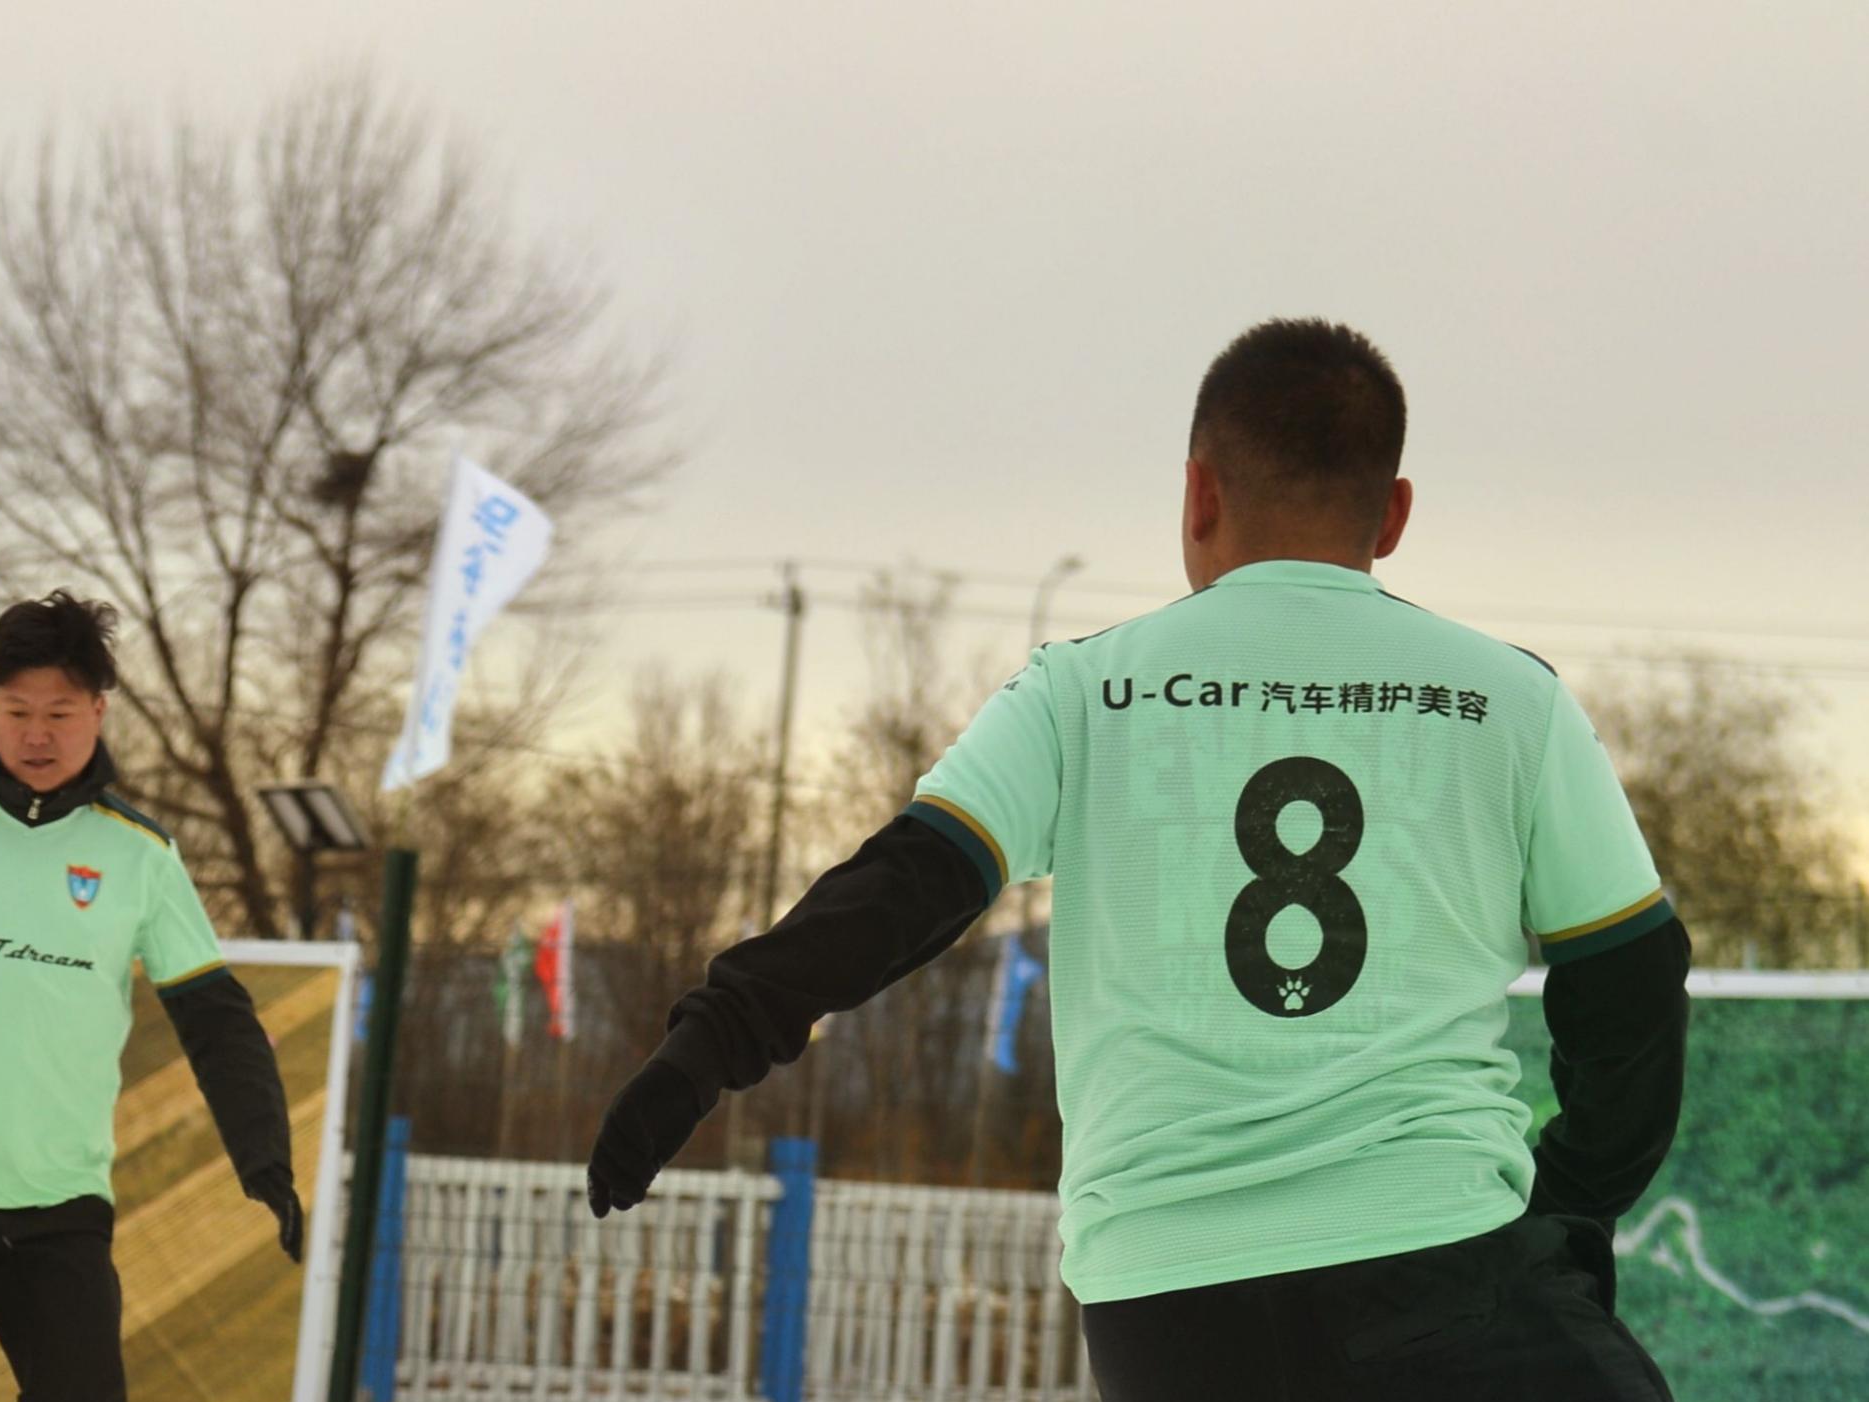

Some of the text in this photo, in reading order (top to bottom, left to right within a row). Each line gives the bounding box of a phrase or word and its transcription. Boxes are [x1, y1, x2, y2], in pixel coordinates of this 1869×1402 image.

[1102, 673, 1250, 711] U-Car
[1261, 680, 1489, 724] 汽车精护美容
[1224, 756, 1368, 1018] 8
